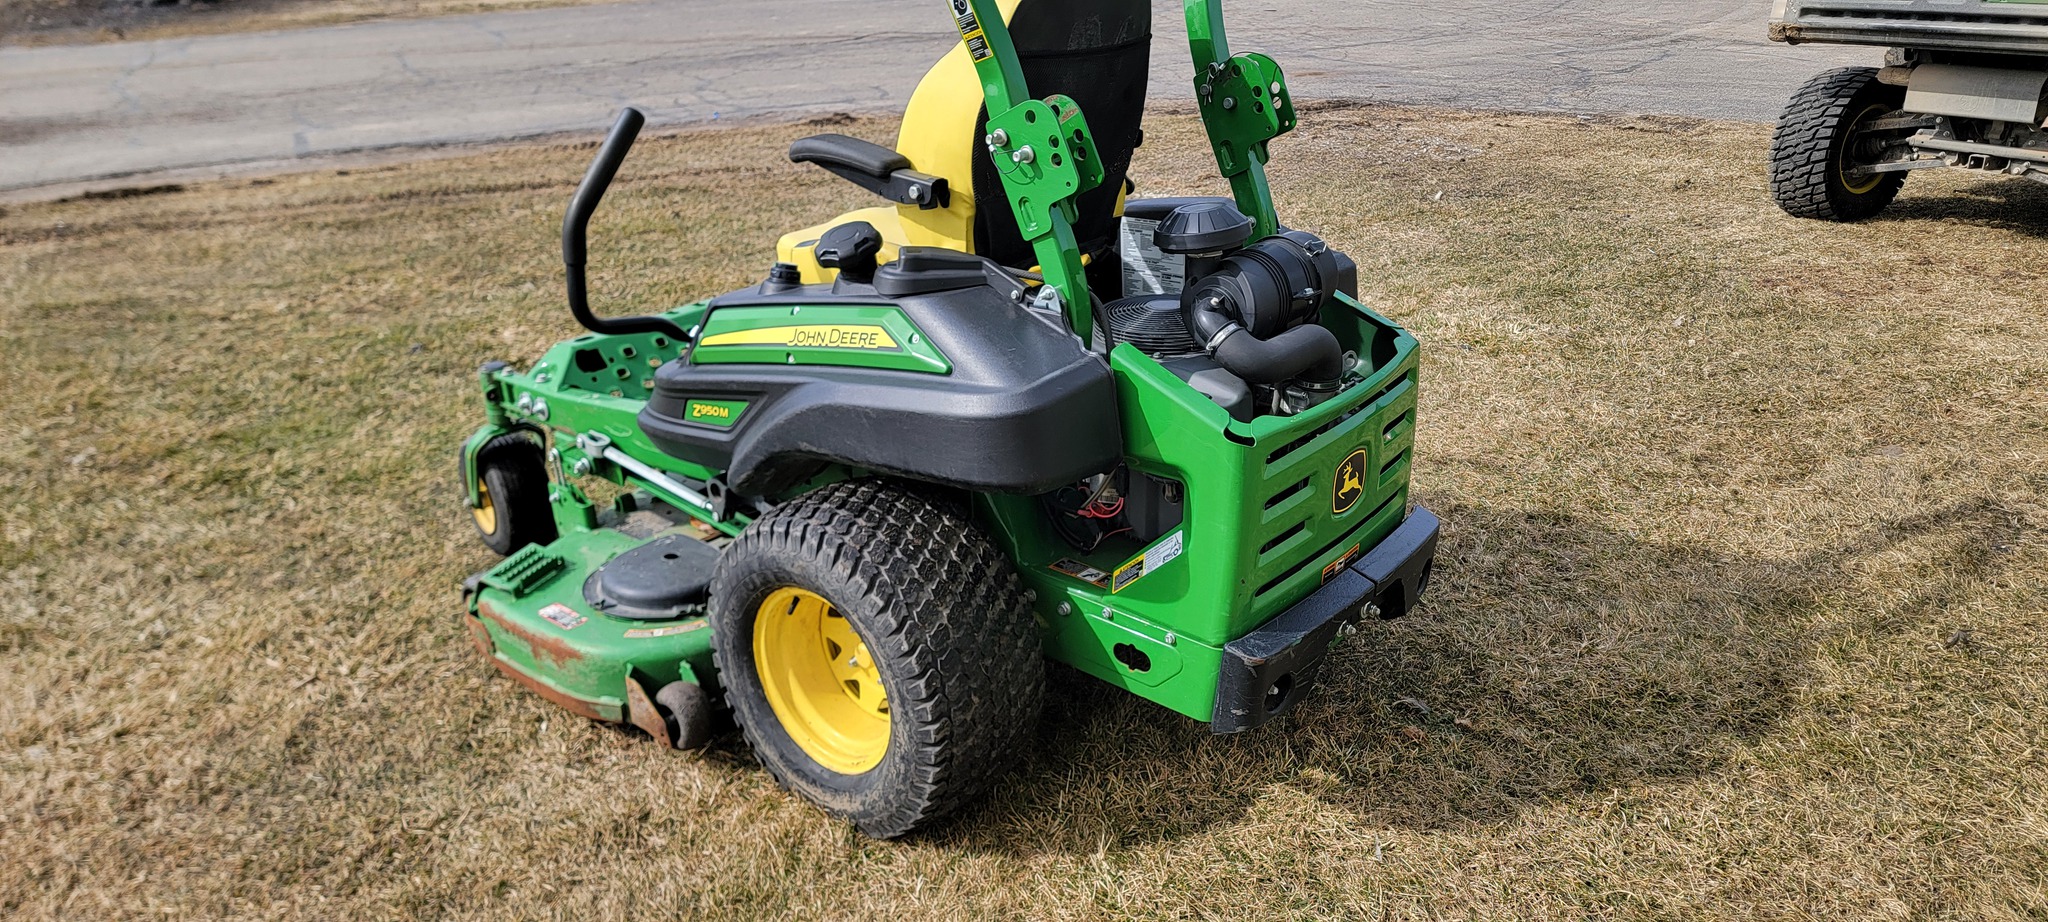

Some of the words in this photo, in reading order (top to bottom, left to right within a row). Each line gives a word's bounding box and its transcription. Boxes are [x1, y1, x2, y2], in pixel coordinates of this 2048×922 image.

[788, 328, 827, 344] JOHN
[829, 328, 879, 346] DEERE
[692, 403, 729, 418] Z950M
